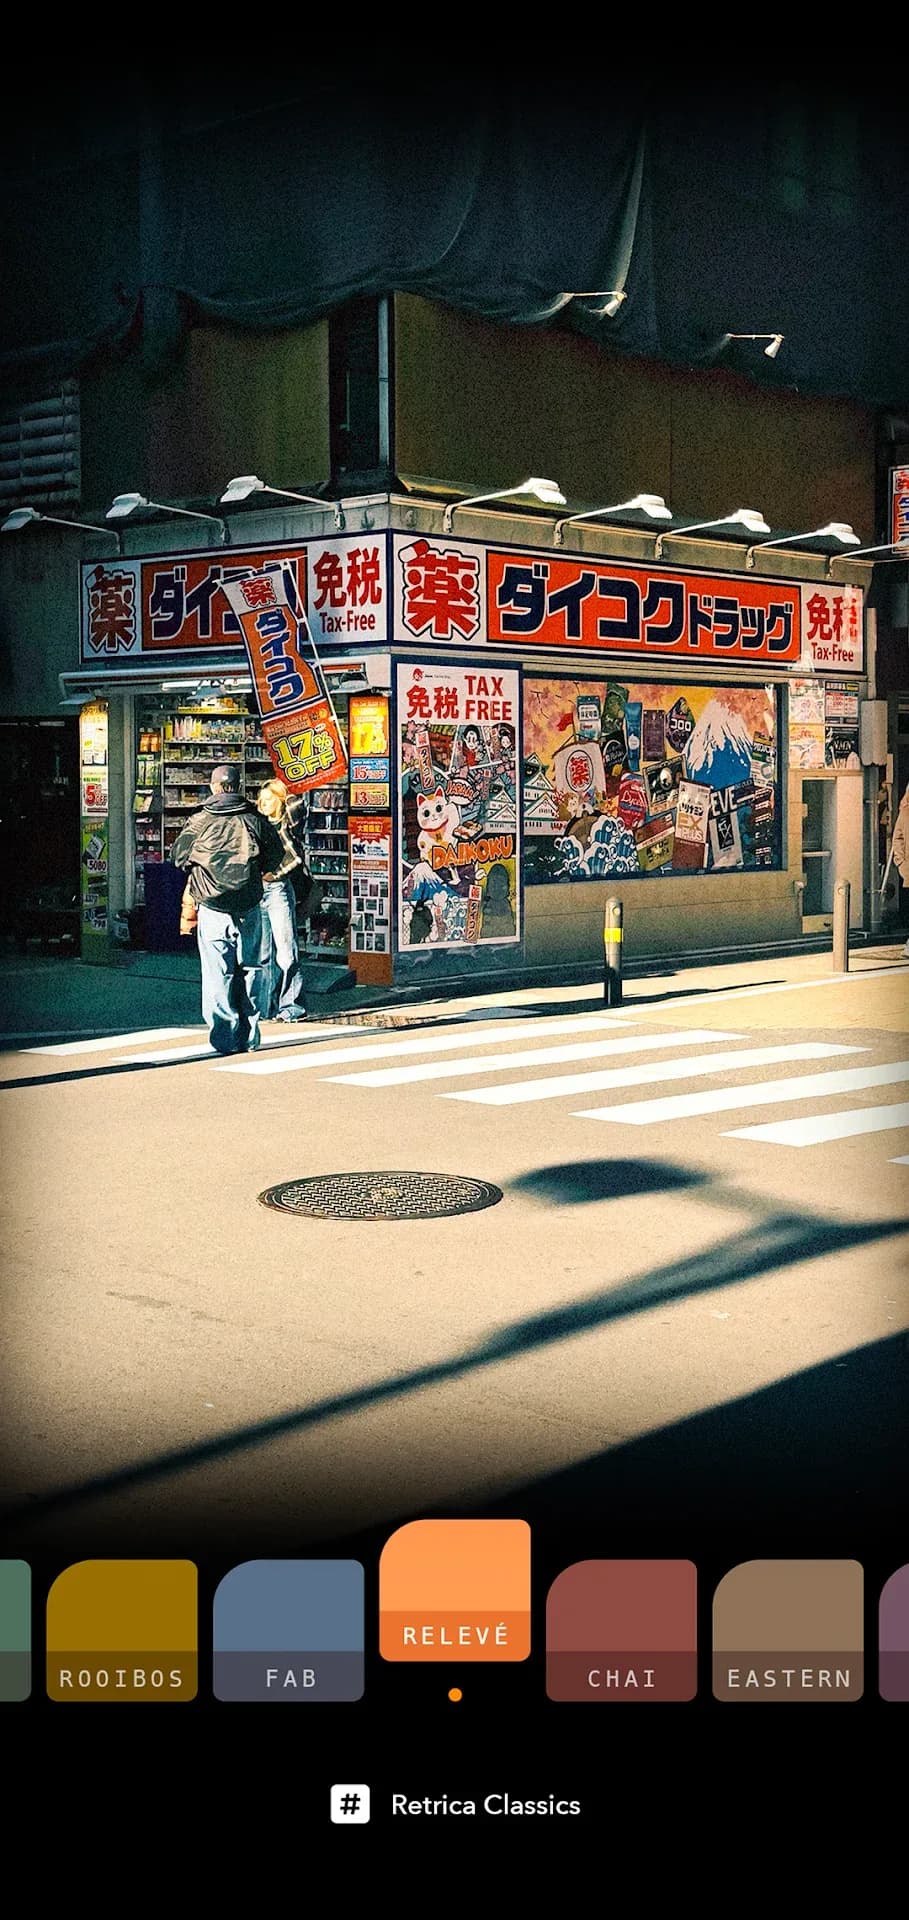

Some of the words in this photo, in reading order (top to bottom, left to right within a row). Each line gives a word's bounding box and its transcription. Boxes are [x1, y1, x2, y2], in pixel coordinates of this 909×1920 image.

[239, 577, 276, 608] 薬
[313, 547, 382, 609] 免税
[86, 565, 136, 653] 薬
[398, 539, 480, 640] 薬
[497, 562, 793, 652] ダイコクドラッグ
[320, 612, 376, 633] Tax-Free
[255, 608, 304, 706] ダイコク
[811, 642, 854, 662] Tax-Free
[406, 685, 460, 719] 免税
[464, 675, 504, 697] TAX
[465, 700, 513, 720] FREE
[272, 729, 334, 768] 17%
[285, 750, 336, 781] OFF
[710, 785, 737, 817] EVE
[432, 835, 513, 872] DAIKOKU
